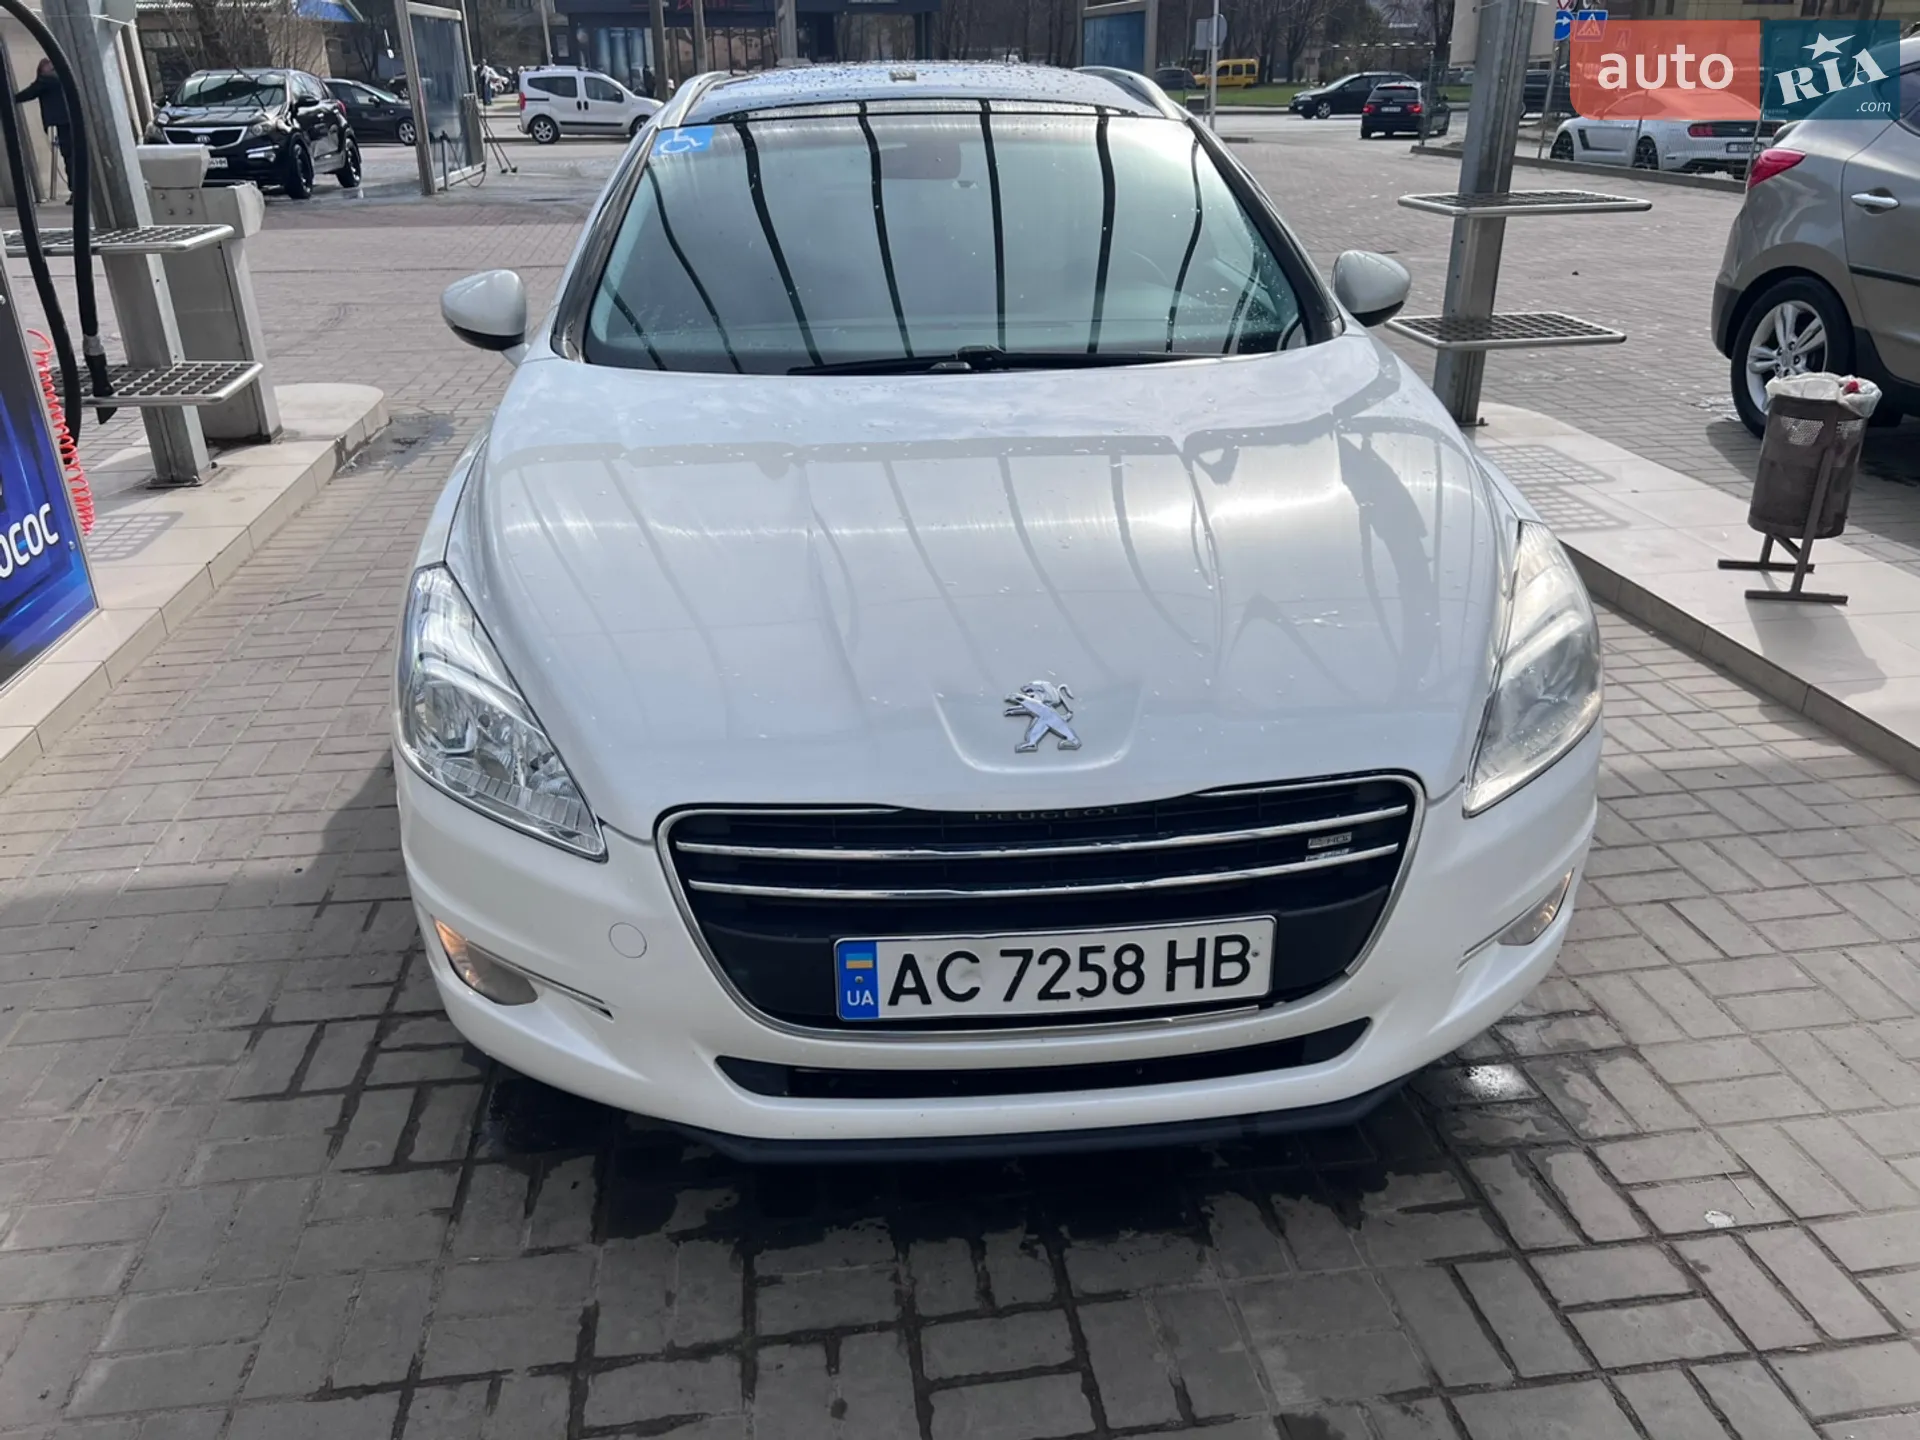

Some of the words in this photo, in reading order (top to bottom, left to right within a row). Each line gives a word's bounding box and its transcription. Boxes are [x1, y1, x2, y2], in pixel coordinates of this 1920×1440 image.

[887, 950, 981, 1006] AC
[1000, 943, 1146, 1001] 7258
[1166, 934, 1251, 992] HB
[846, 989, 875, 1007] UA
